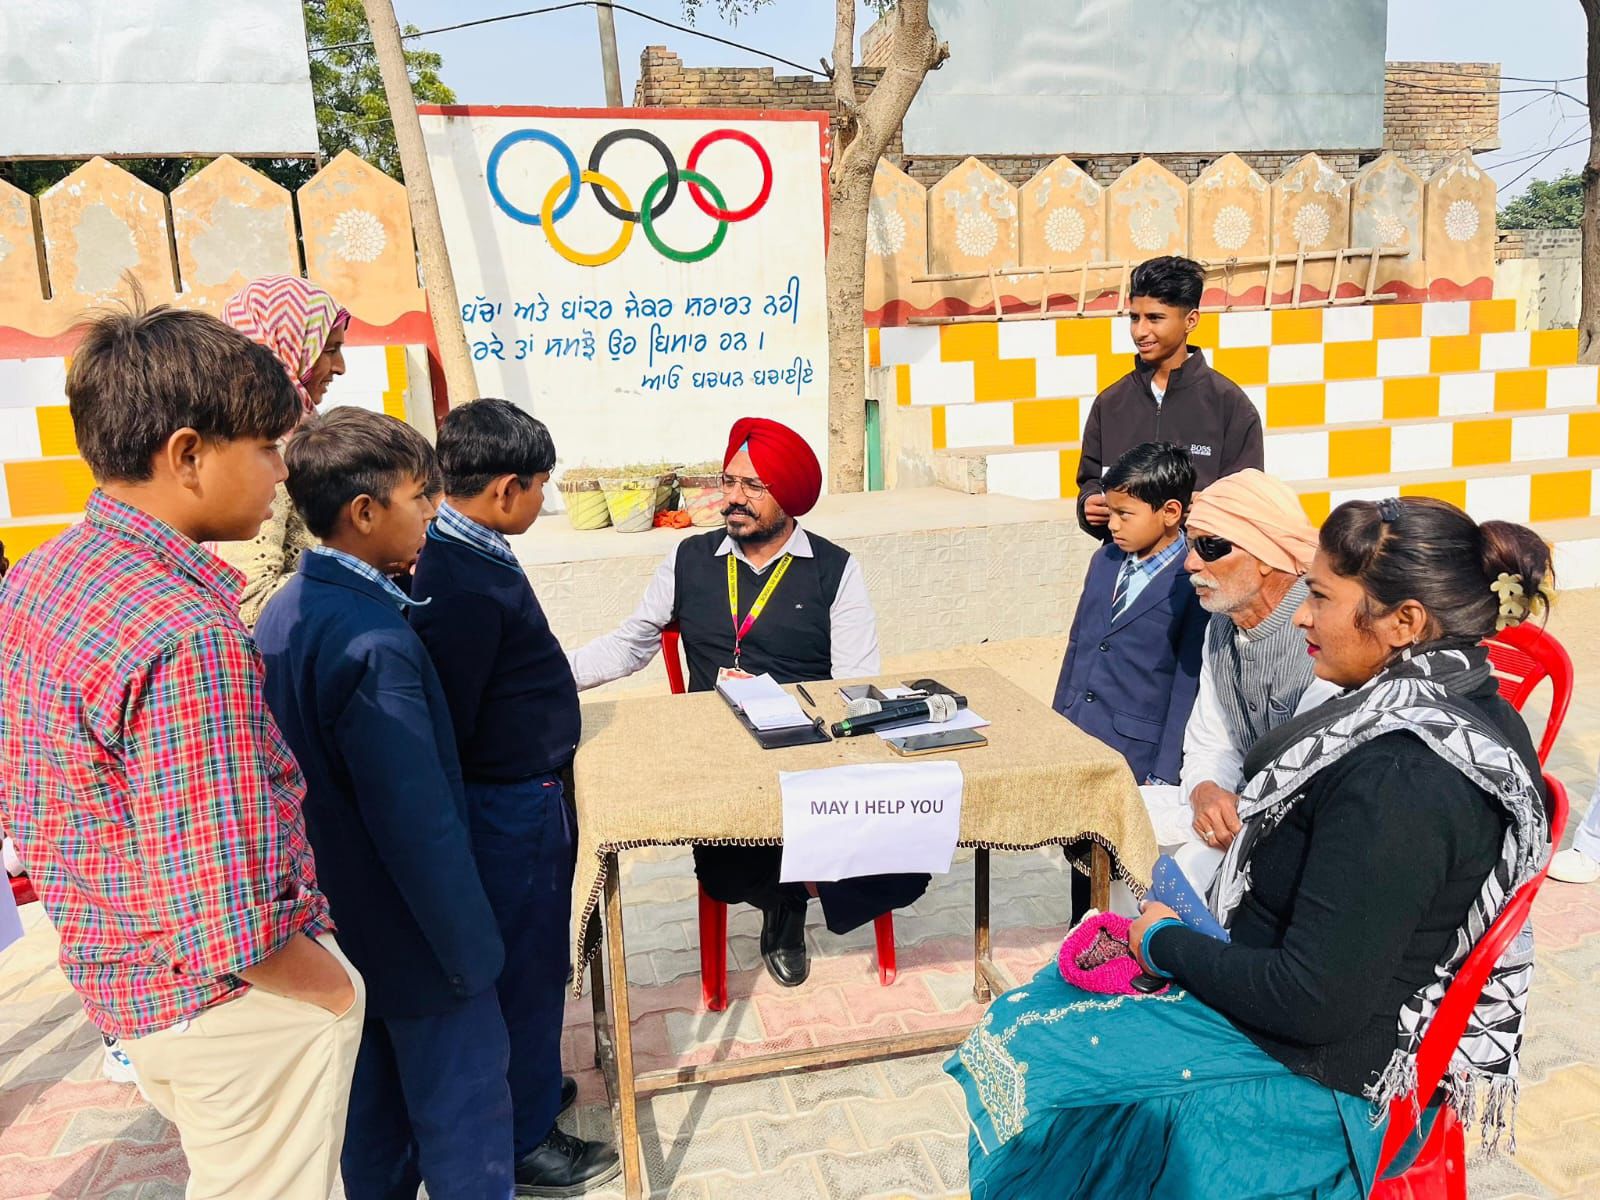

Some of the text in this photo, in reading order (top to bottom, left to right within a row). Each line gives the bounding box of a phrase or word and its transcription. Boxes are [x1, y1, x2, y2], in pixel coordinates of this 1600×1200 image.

[462, 296, 503, 324] ਬੱਚਾ
[513, 292, 550, 322] ਅਤੇ
[561, 295, 613, 321] ਬਾਂਦਰ
[625, 290, 673, 319] ਜੇਕਰ
[684, 296, 753, 318] ਸ਼ਰਾਰਤ
[473, 332, 507, 362] ਰਦੇ
[515, 334, 534, 361] ਤਾਂ
[608, 328, 638, 361] ਉਹ
[649, 322, 707, 368] ਬਿਮਾਰ
[719, 332, 748, 351] ਹਨ
[641, 356, 814, 396] ਆਓ ਬਚਪਨ ਬਚਾਈਏ
[1190, 443, 1211, 452] BOSS
[811, 799, 944, 815] MAY I HELP YOU
